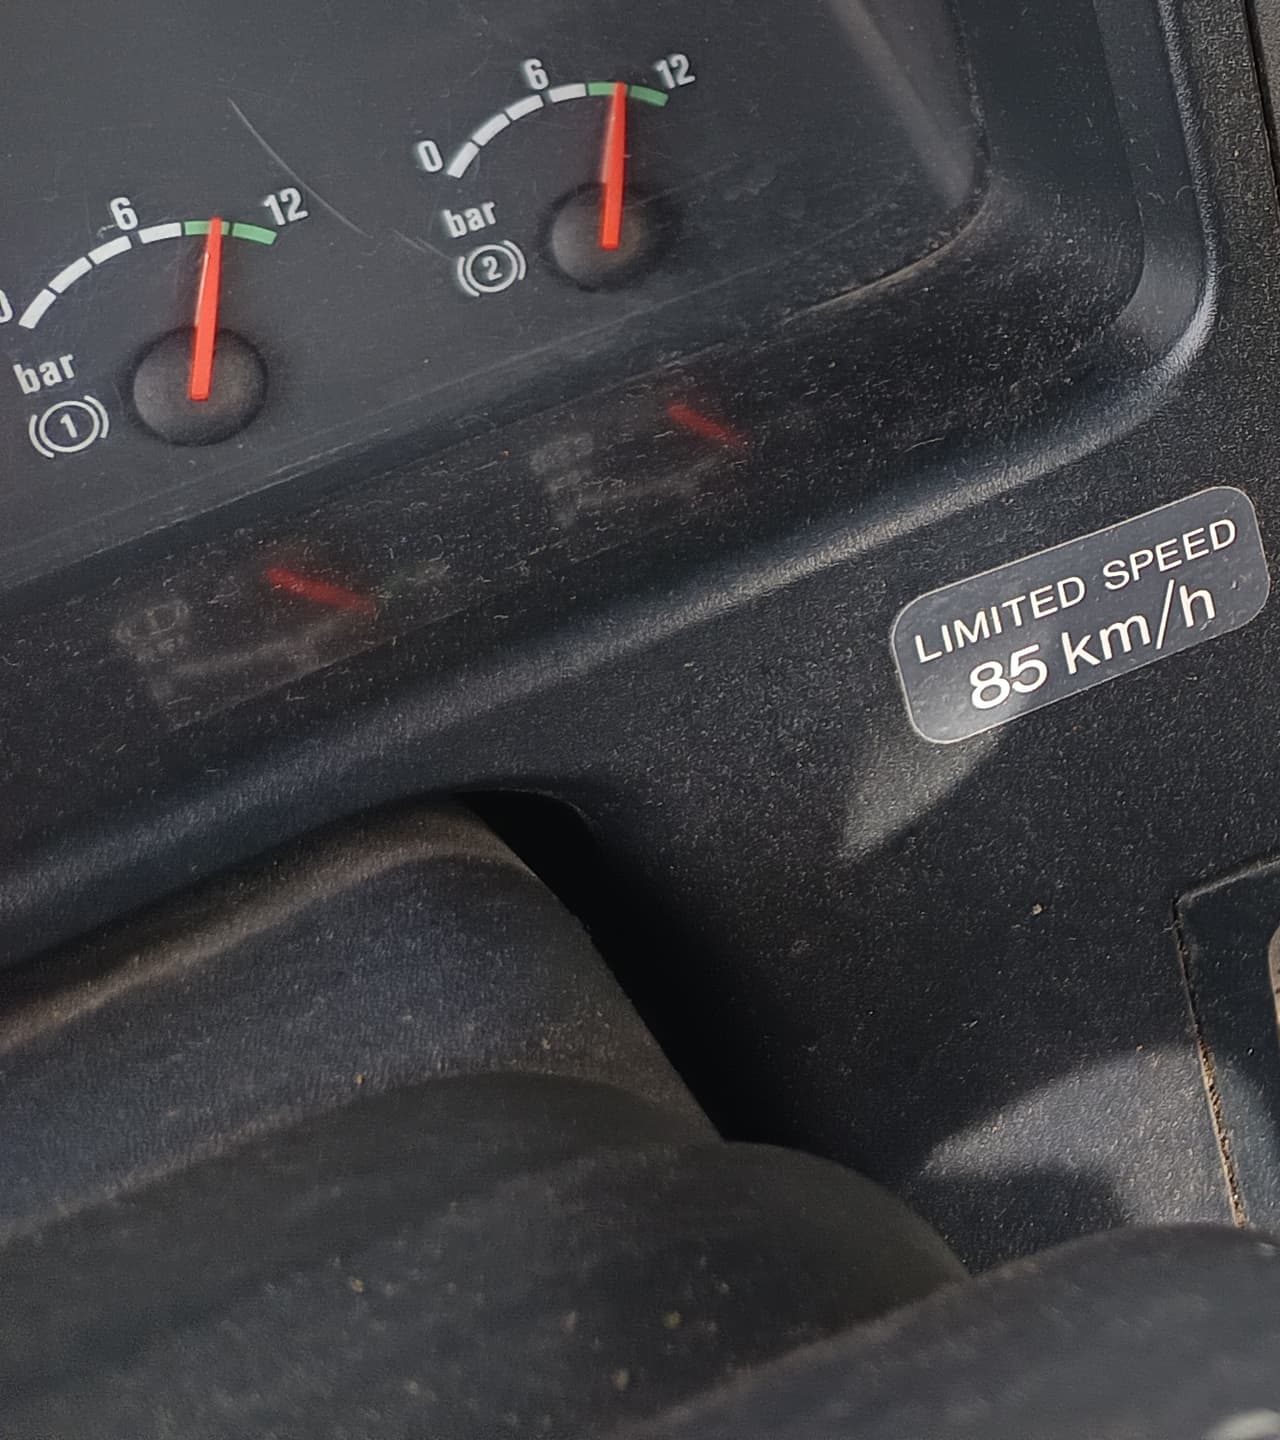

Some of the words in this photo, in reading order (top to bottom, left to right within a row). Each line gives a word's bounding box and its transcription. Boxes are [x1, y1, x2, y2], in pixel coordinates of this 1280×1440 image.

[524, 58, 549, 90] 6
[655, 54, 696, 89] 12
[417, 140, 443, 173] 0
[110, 197, 138, 230] 6
[261, 187, 308, 226] 12
[443, 201, 496, 238] bar
[483, 256, 502, 280] 2
[13, 354, 75, 395] bar
[60, 414, 77, 438] 1
[914, 575, 1086, 663] LIMITED
[1102, 518, 1238, 591] SPEED
[969, 645, 1048, 710] 85
[1061, 578, 1217, 674] km/h
